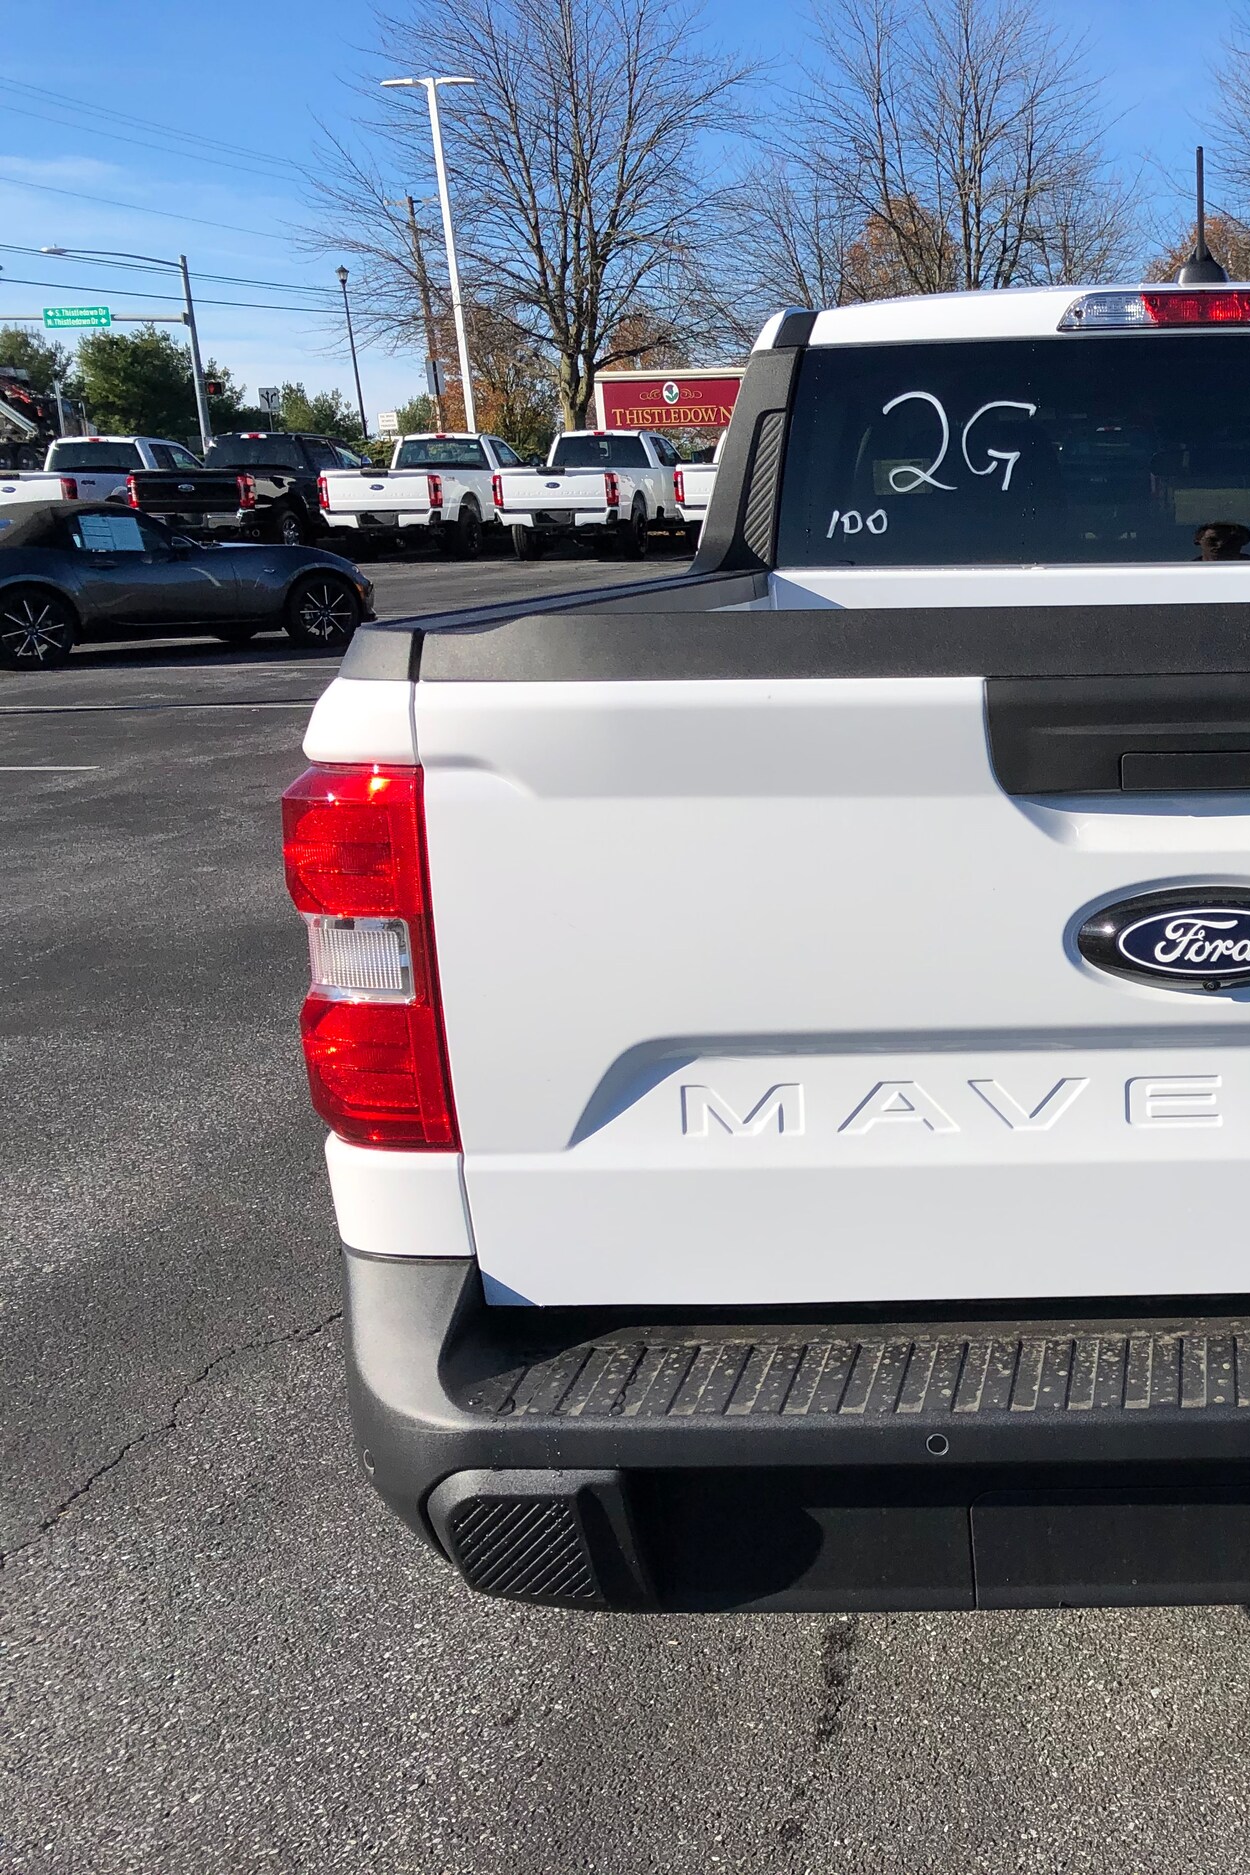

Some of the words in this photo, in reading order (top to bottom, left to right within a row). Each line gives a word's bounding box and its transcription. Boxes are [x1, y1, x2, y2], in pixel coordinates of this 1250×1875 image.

[62, 308, 98, 316] Thistledown
[55, 318, 91, 326] Thistledown
[91, 317, 98, 325] Dr
[826, 508, 888, 538] 100
